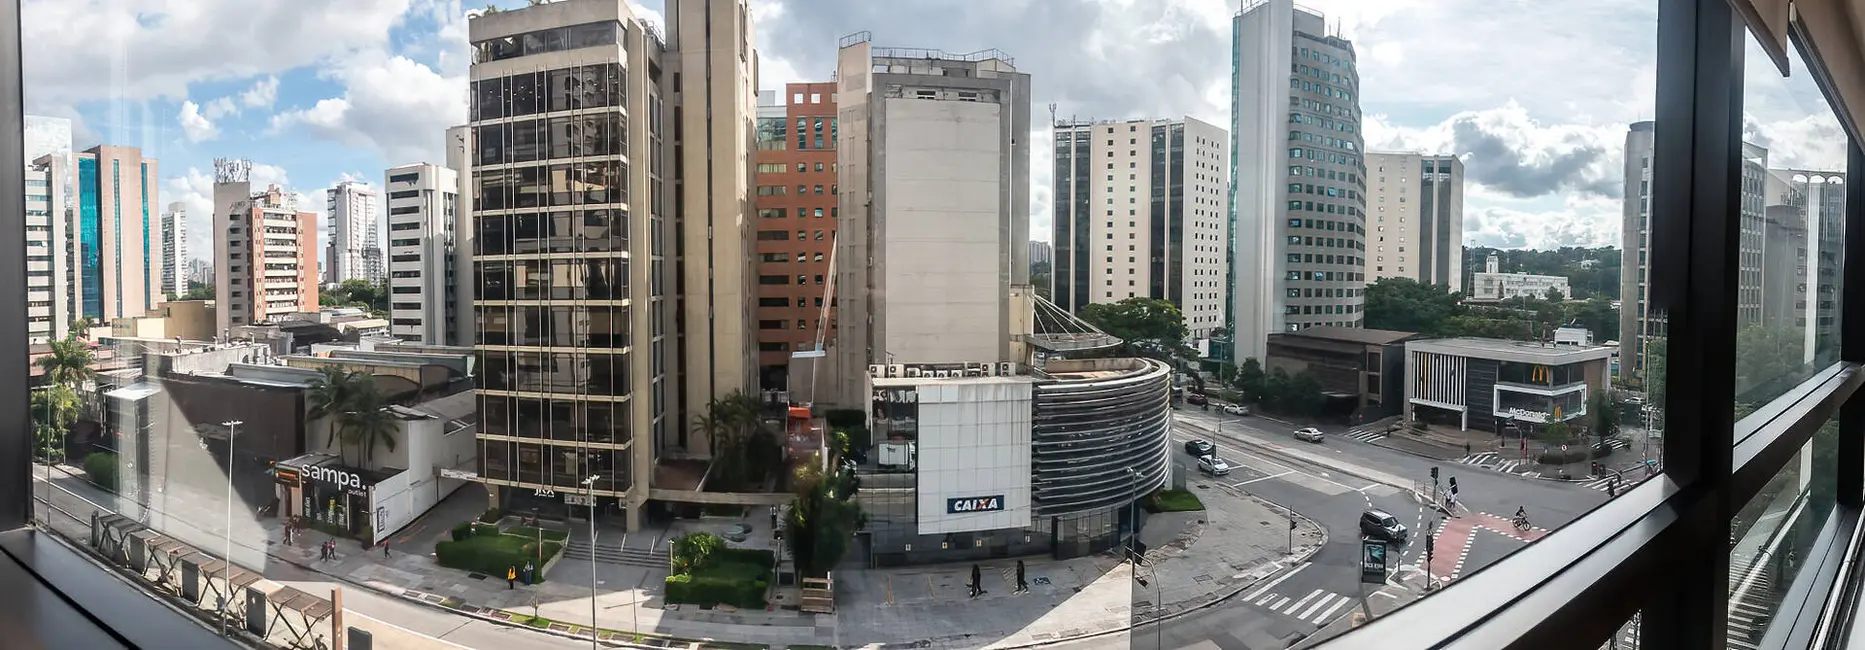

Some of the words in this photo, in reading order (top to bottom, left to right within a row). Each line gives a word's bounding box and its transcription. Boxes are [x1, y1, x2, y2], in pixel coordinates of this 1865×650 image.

[301, 464, 368, 490] sampa.
[348, 489, 367, 498] outlet
[954, 498, 998, 511] CAIXA
